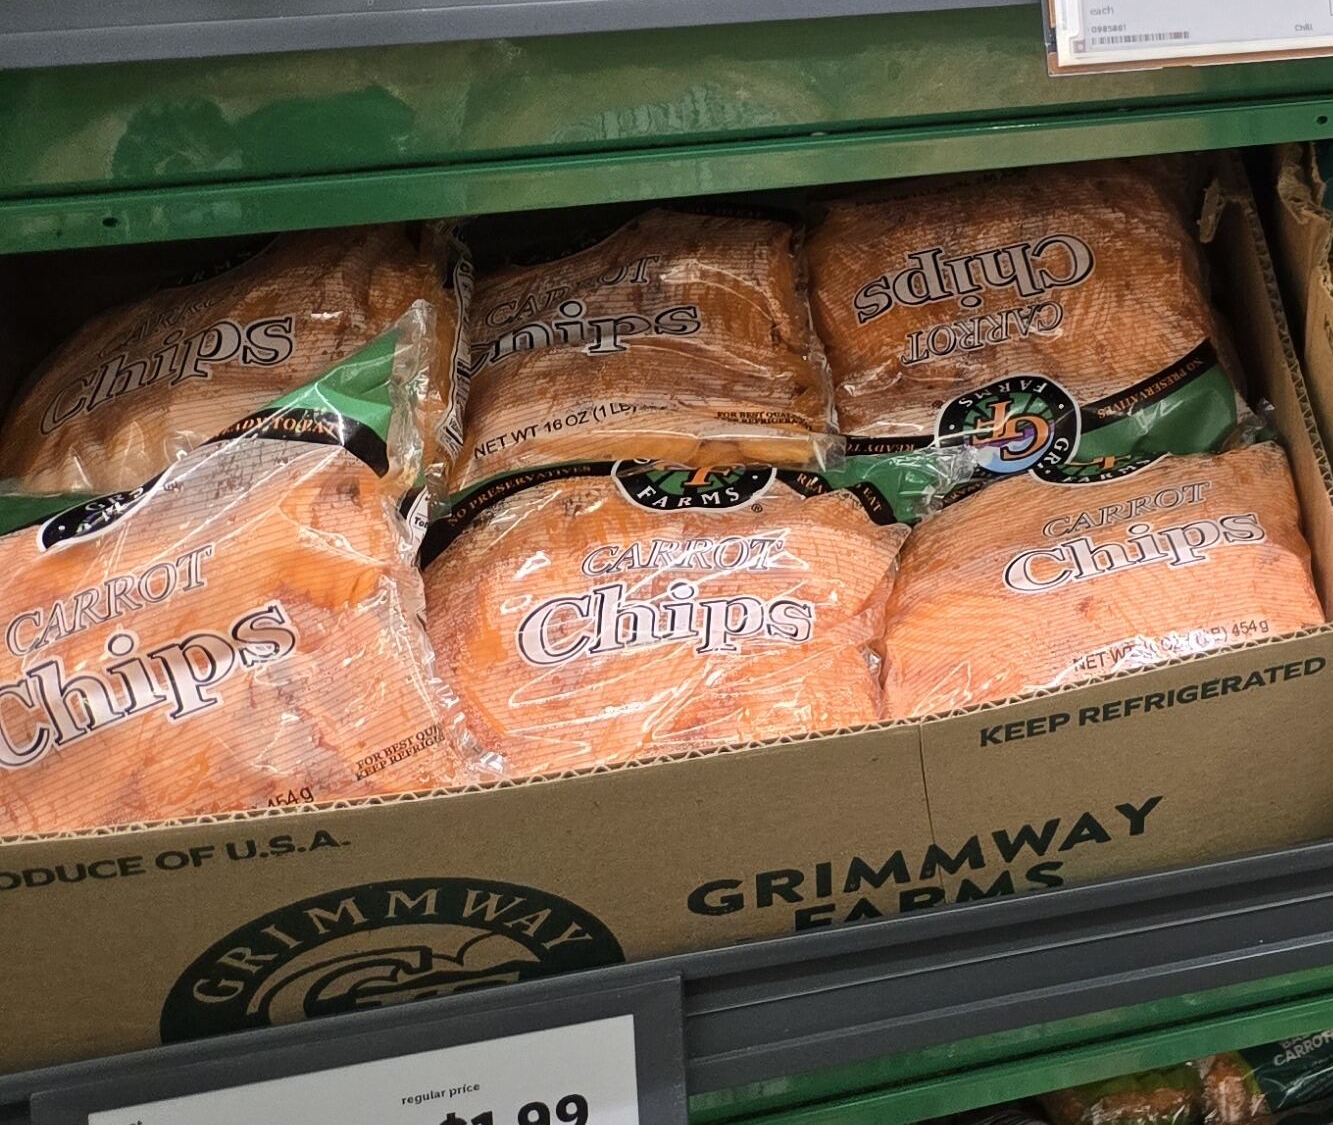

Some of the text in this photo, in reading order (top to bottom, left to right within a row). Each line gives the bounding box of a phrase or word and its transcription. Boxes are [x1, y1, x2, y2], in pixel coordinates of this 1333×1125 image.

[854, 233, 1095, 324] Chips
[901, 300, 1065, 366] CARROT
[40, 315, 296, 436] Chips
[957, 377, 1049, 409] FARMS
[475, 434, 508, 459] NET
[512, 422, 540, 445] WT
[543, 418, 564, 434] 16
[565, 411, 588, 429] OZ
[636, 485, 742, 511] FARMS
[1042, 480, 1212, 539] CARROT
[581, 535, 787, 577] CARROT
[1001, 513, 1267, 595] Chips
[6, 543, 216, 658] CARROT
[517, 581, 815, 667] Chips
[0, 603, 297, 766] Chips
[1073, 649, 1108, 672] NET
[979, 656, 1328, 748] KEEP REFRIGERATED
[0, 830, 352, 891] ODUCE OF U.S.A.
[686, 795, 1164, 917] GRIMMWAY
[192, 887, 594, 1007] GRIMMWAY
[402, 1081, 481, 1106] regular price
